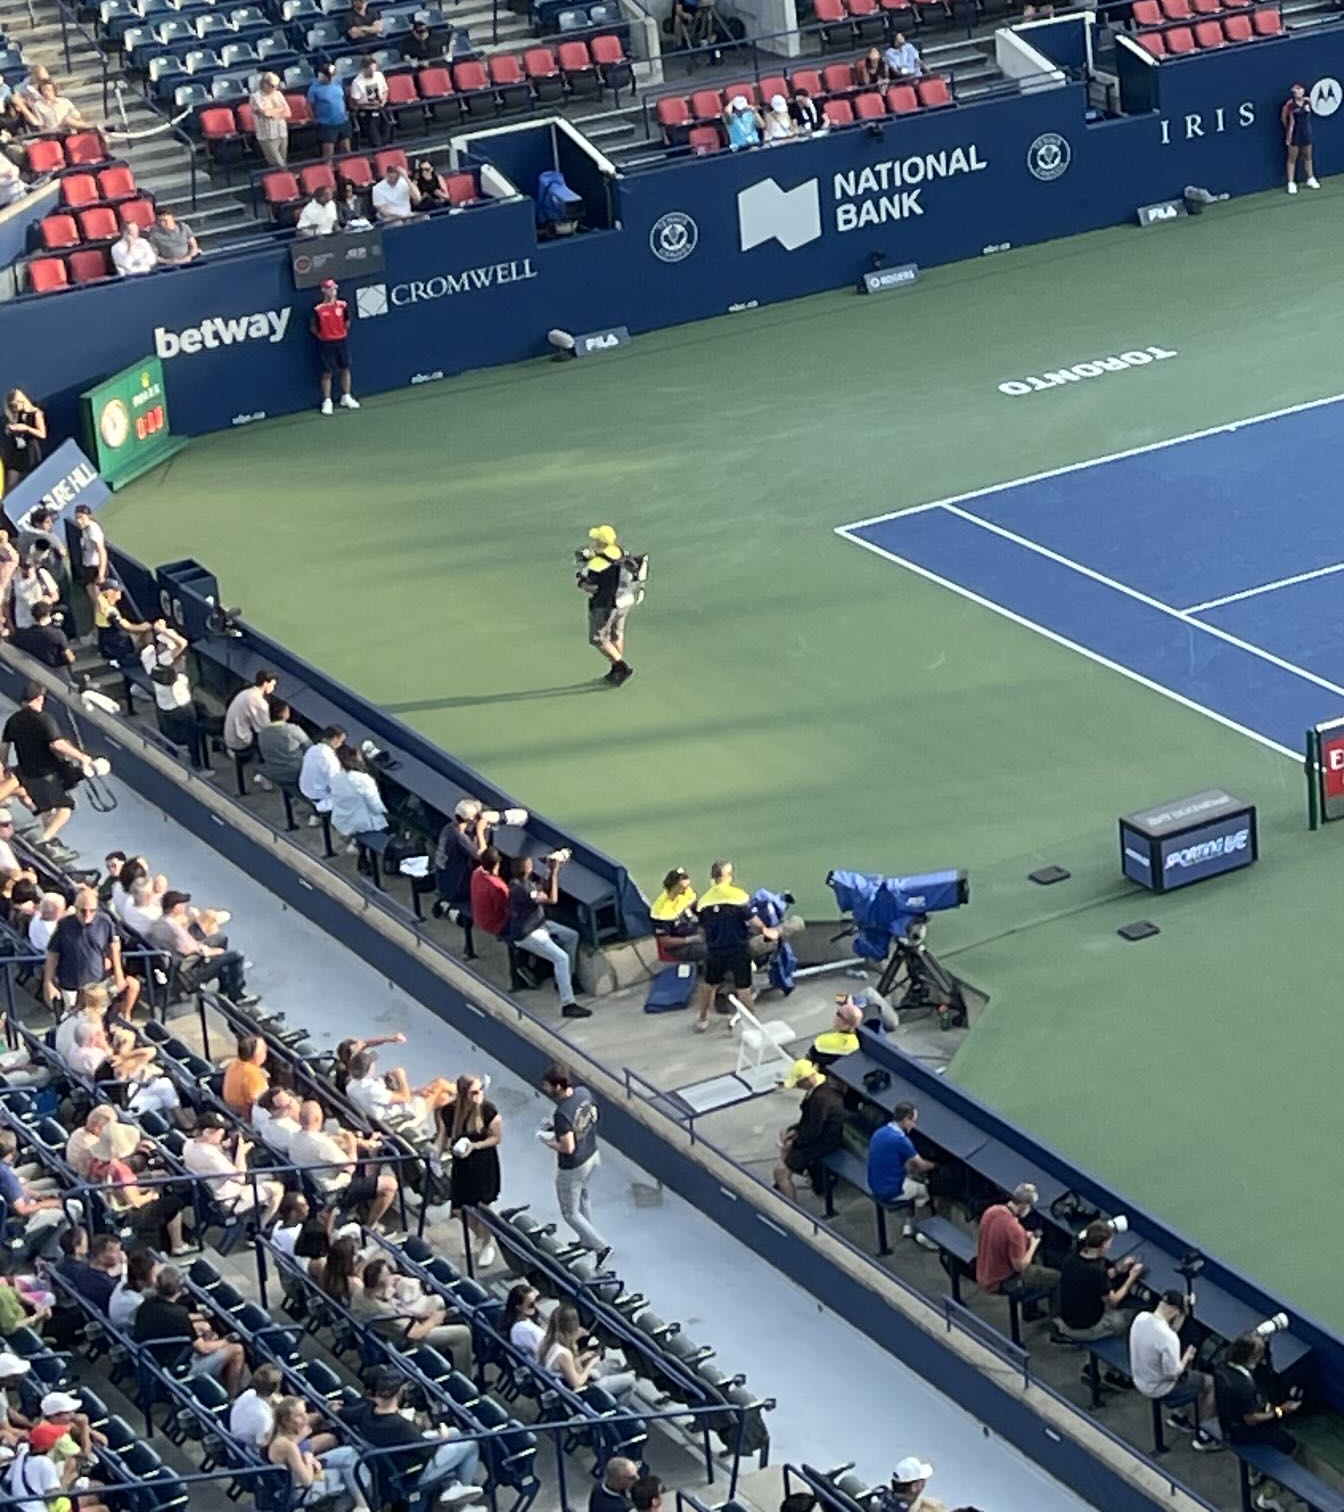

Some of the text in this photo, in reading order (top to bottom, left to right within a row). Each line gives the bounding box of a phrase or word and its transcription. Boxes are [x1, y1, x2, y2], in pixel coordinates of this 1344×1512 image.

[1160, 102, 1256, 145] IRIS
[833, 144, 988, 199] NATIONAL
[836, 190, 924, 232] BANK
[1149, 205, 1177, 221] FILA
[391, 258, 537, 308] CROMWELL
[155, 306, 293, 360] betway
[586, 334, 619, 351] FILA
[999, 345, 1177, 397] TORONTO
